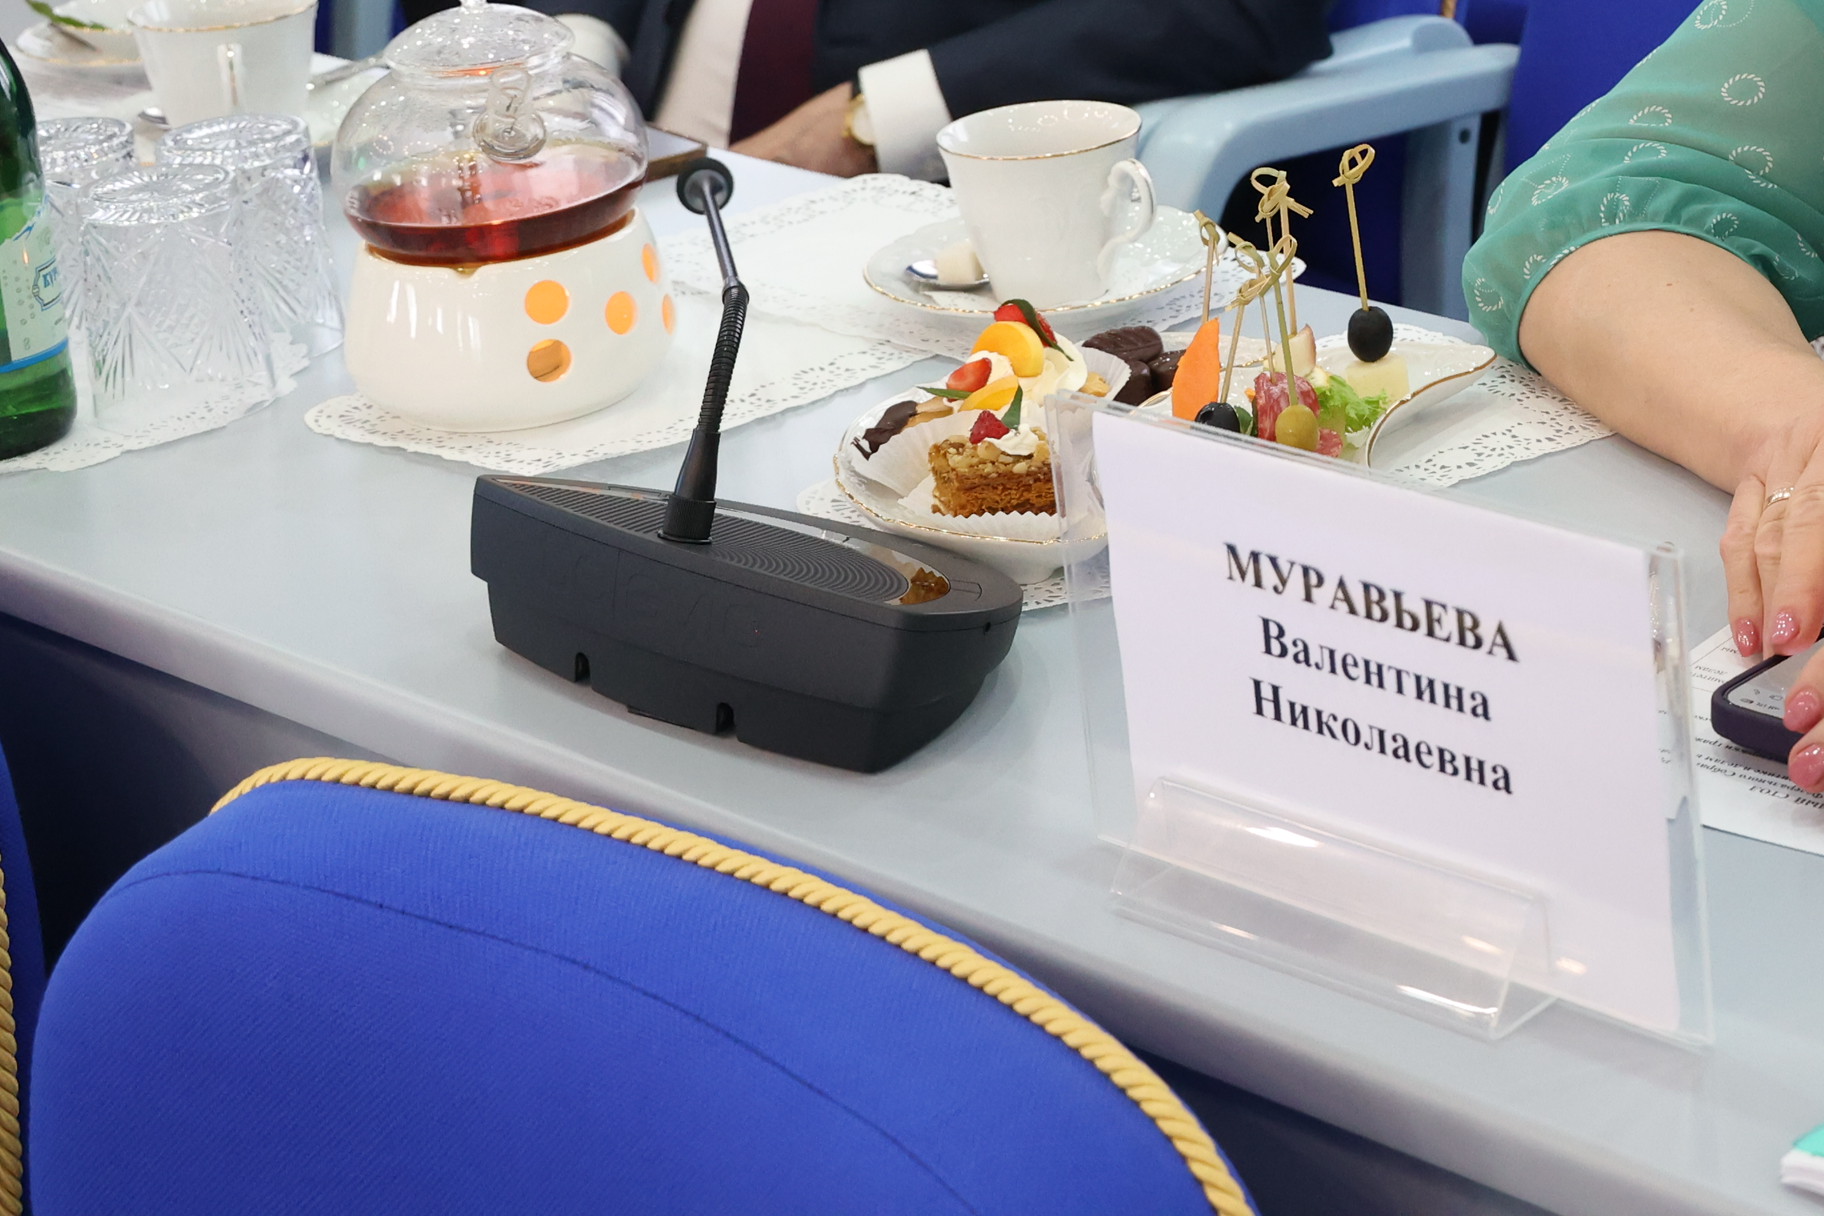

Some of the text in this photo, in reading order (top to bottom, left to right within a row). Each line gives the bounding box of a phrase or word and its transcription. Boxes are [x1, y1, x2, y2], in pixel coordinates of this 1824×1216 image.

[1223, 541, 1520, 663] МУРАВЬЕВА
[1258, 616, 1492, 721] Валентина
[1248, 677, 1513, 795] Николаевна
